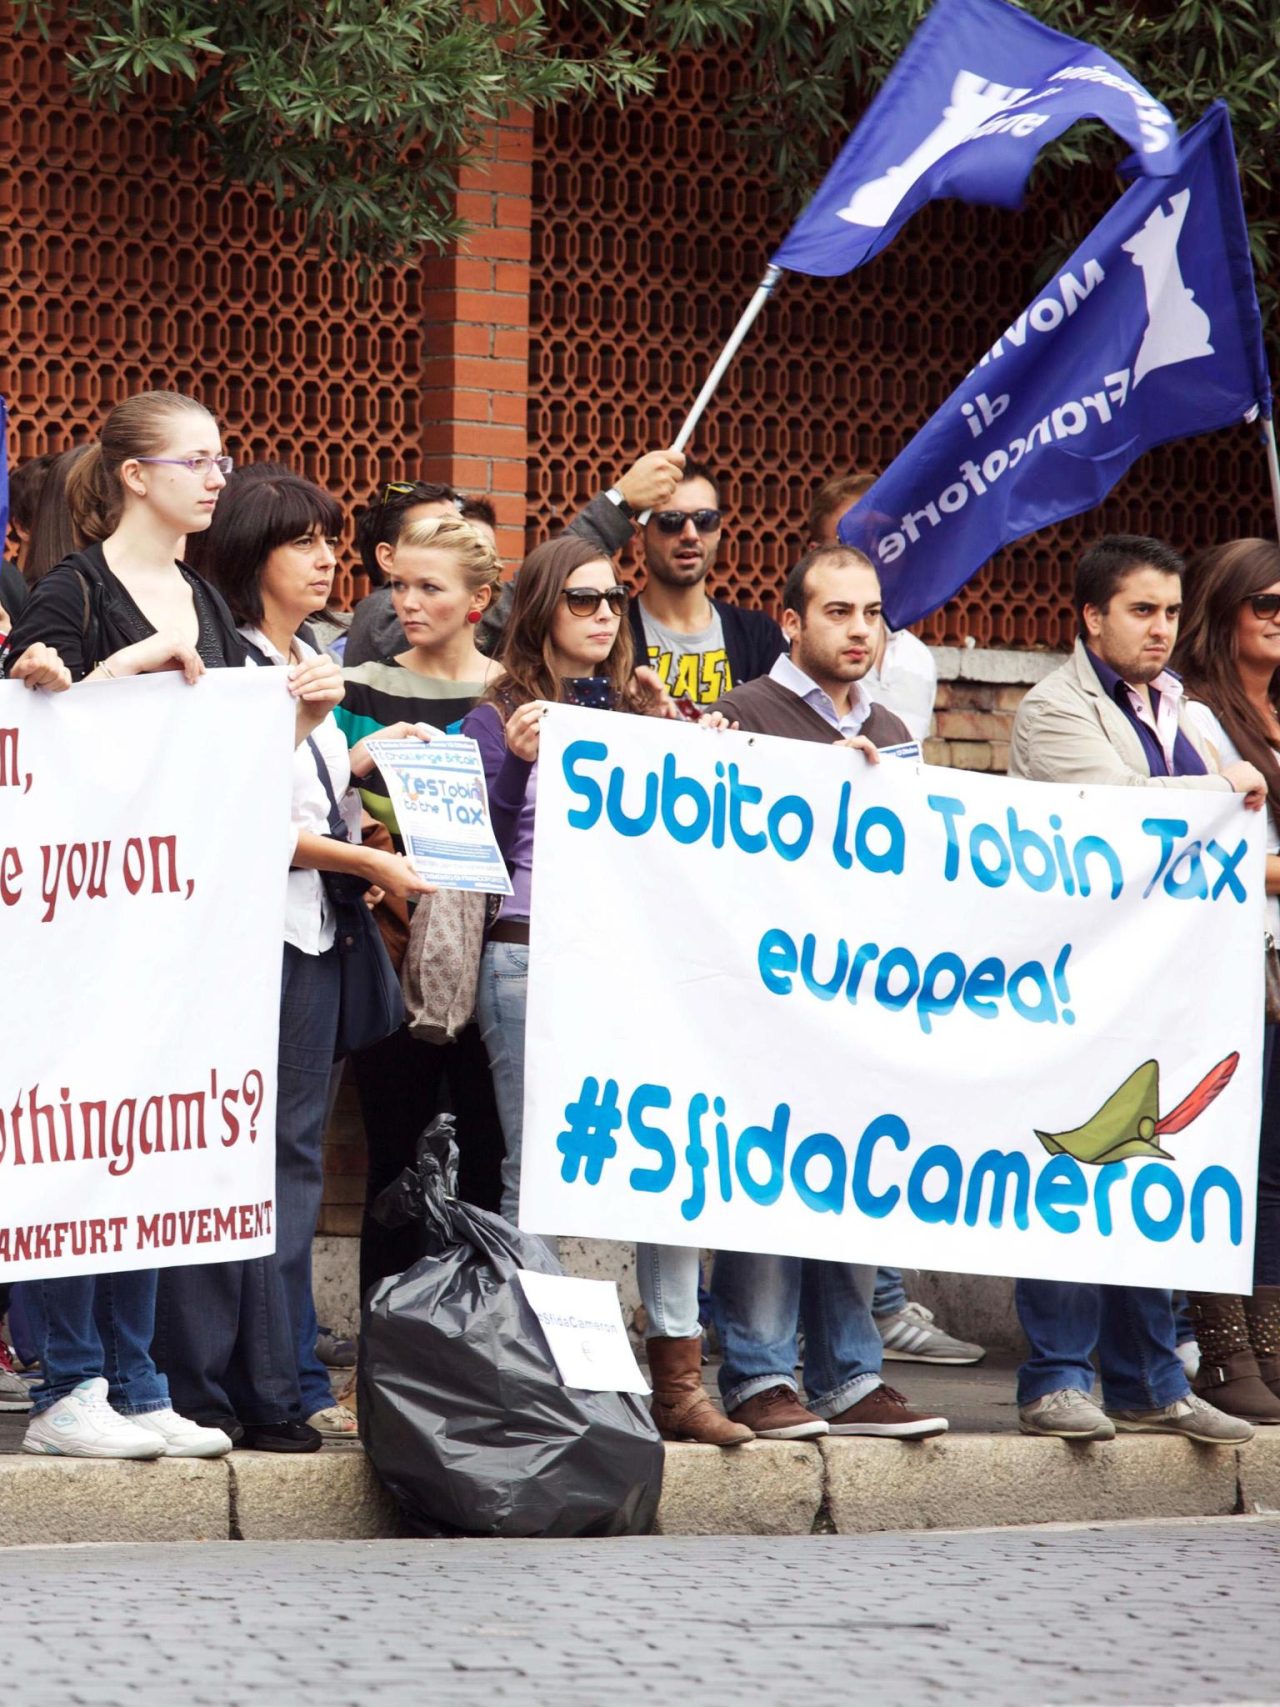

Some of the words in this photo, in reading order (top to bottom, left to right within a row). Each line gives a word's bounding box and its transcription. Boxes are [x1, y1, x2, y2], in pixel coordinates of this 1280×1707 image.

[441, 798, 485, 827] Tax
[561, 740, 814, 862] Subito
[832, 780, 906, 876] la
[927, 794, 1125, 901] Tobin
[1141, 817, 1249, 905] Tax
[41, 840, 110, 922] you
[124, 835, 195, 901] on,
[757, 926, 1076, 1034] europea!
[556, 1076, 1243, 1247] #SfidaCameron
[137, 1201, 273, 1249] MOVEMENT
